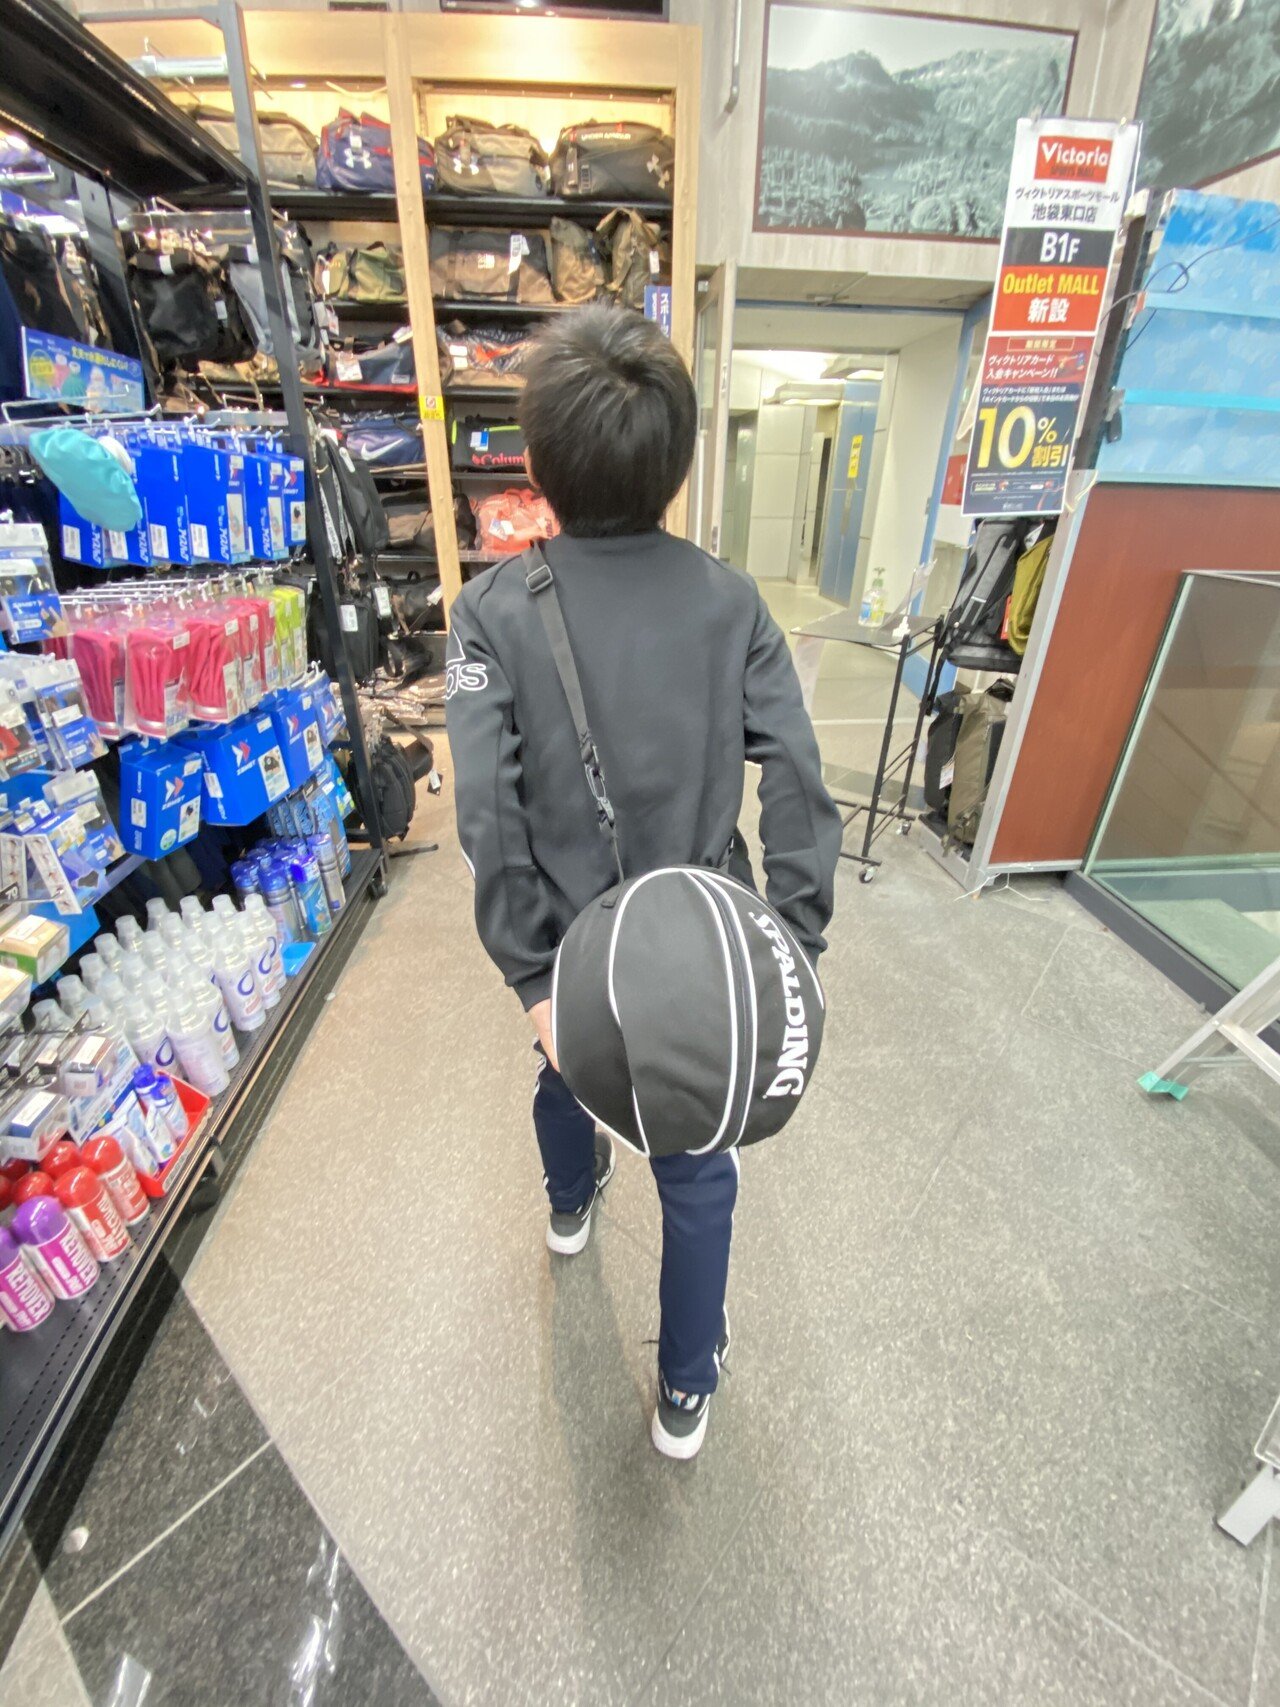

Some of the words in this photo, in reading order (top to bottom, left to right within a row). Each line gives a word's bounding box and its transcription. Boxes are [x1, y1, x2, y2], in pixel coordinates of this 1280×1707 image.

[1041, 142, 1109, 167] Victoria
[1015, 187, 1120, 203] ヴィクトリアスポーツモール
[1032, 203, 1098, 223] 池袋東口店
[1040, 231, 1080, 263] B1F
[1002, 273, 1055, 295] Outlet
[1056, 273, 1100, 296] MALL
[1027, 297, 1070, 324] 新設
[988, 353, 1055, 367] ヴィクトリアカード
[1031, 443, 1070, 468] 割引
[749, 911, 809, 1098] SPALDING
[59, 1231, 98, 1286] REMOVER
[5, 1264, 49, 1321] REMOVER
